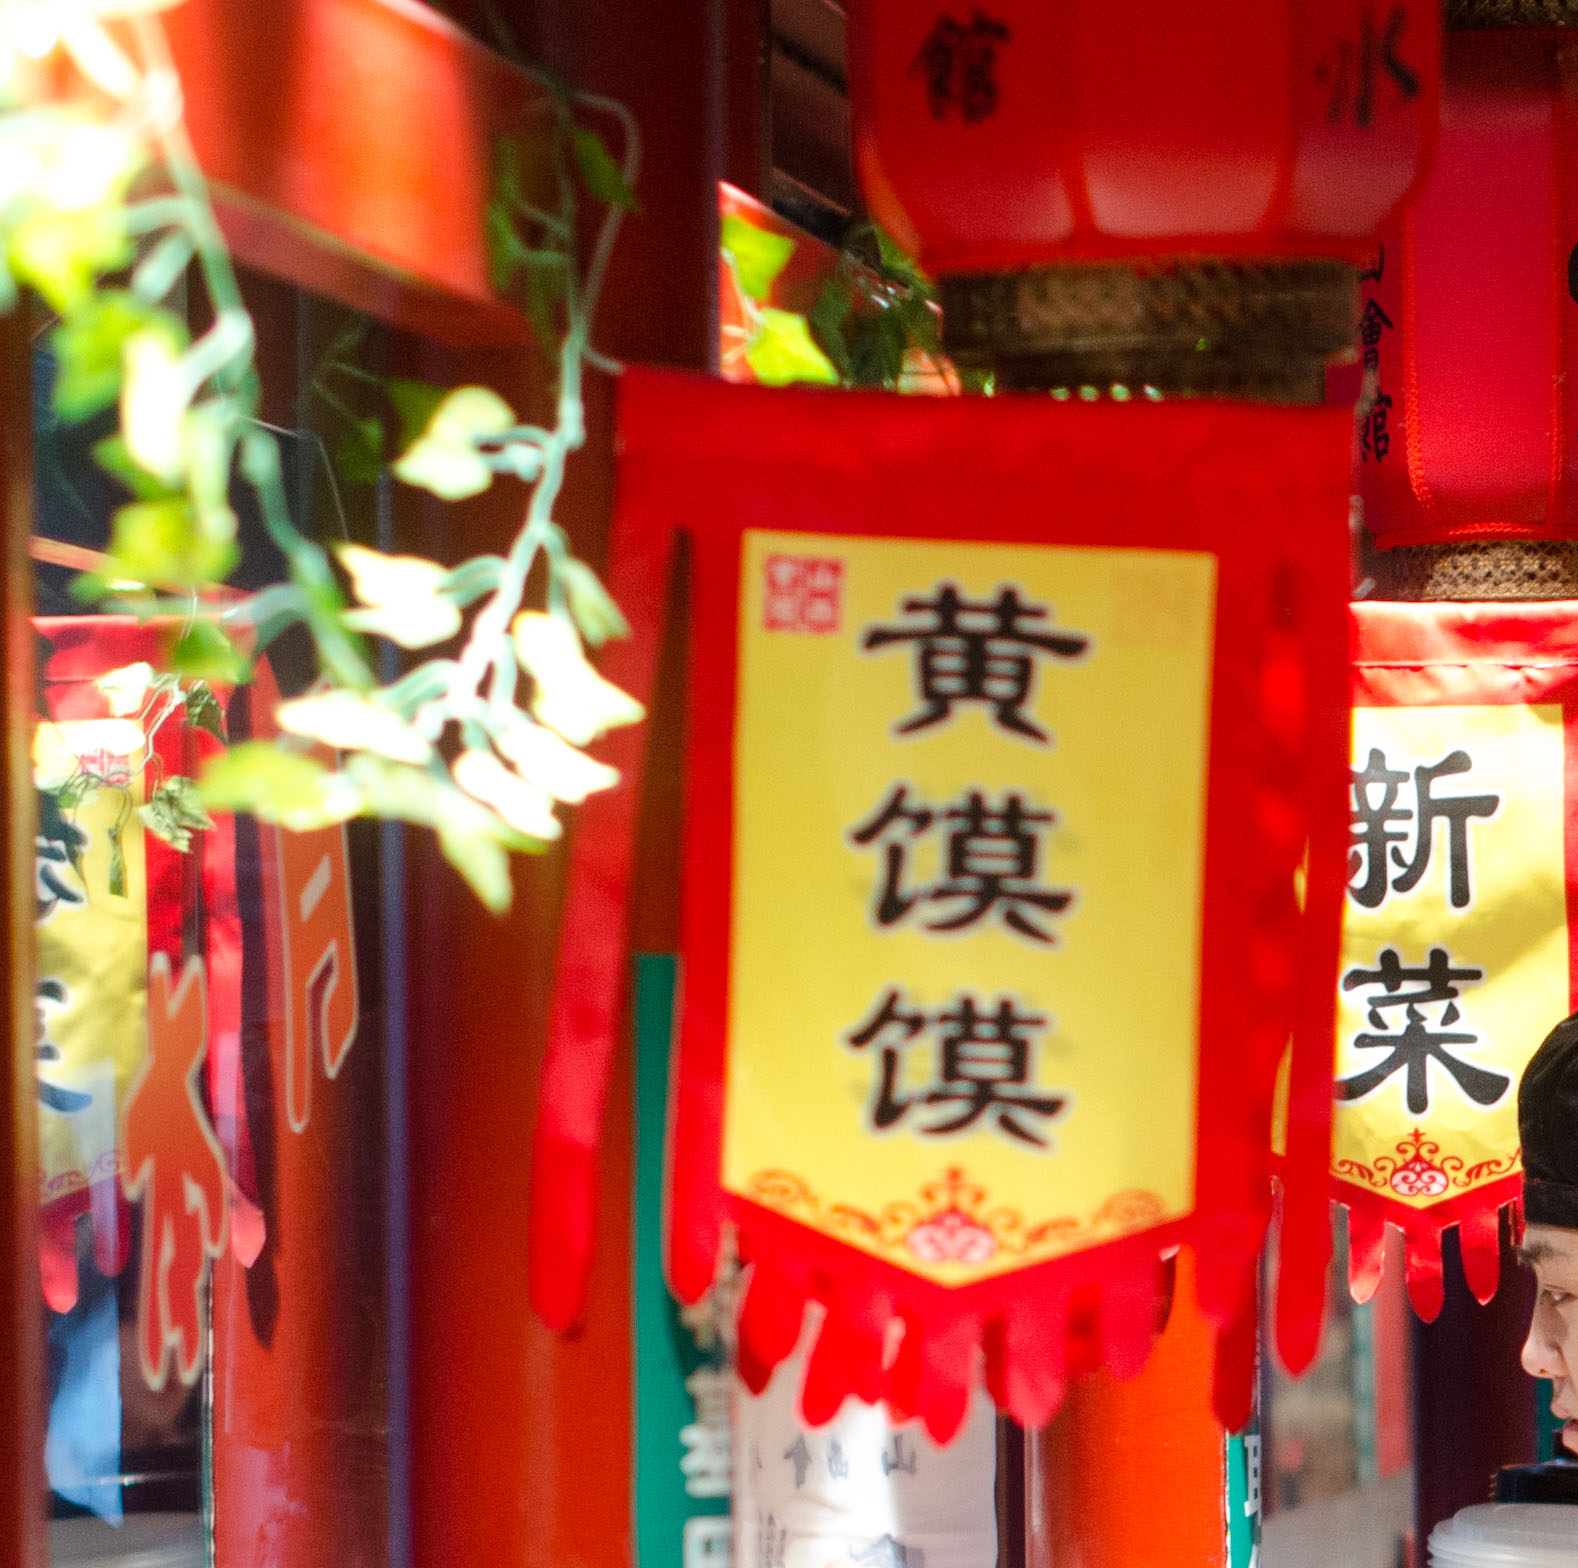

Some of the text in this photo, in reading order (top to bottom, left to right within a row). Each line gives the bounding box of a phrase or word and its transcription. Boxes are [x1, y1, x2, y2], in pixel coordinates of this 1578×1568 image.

[842, 580, 1092, 1152] 黄馍馍
[1340, 747, 1512, 1116] 新菜
